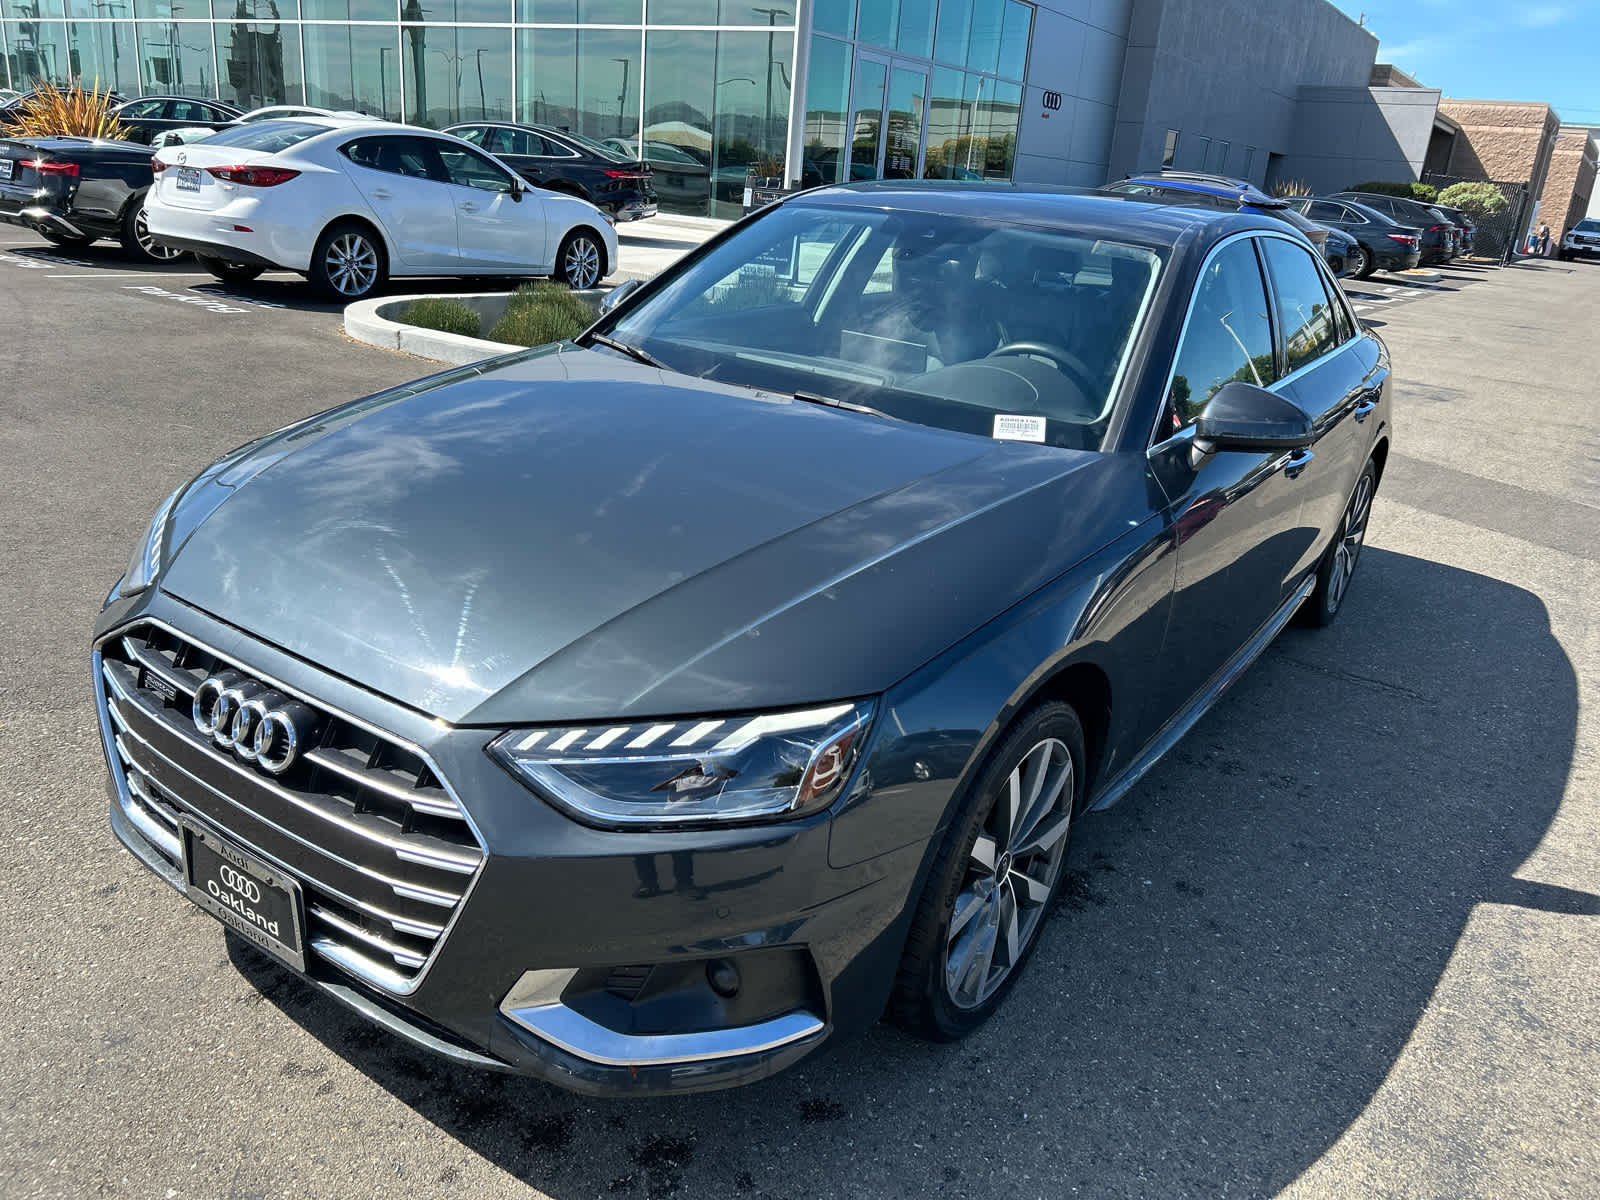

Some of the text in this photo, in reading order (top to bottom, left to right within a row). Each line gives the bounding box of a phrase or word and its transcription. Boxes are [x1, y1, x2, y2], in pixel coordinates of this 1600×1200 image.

[220, 846, 249, 870] Audi
[207, 879, 279, 937] Oakland
[218, 907, 270, 946] Oakland
